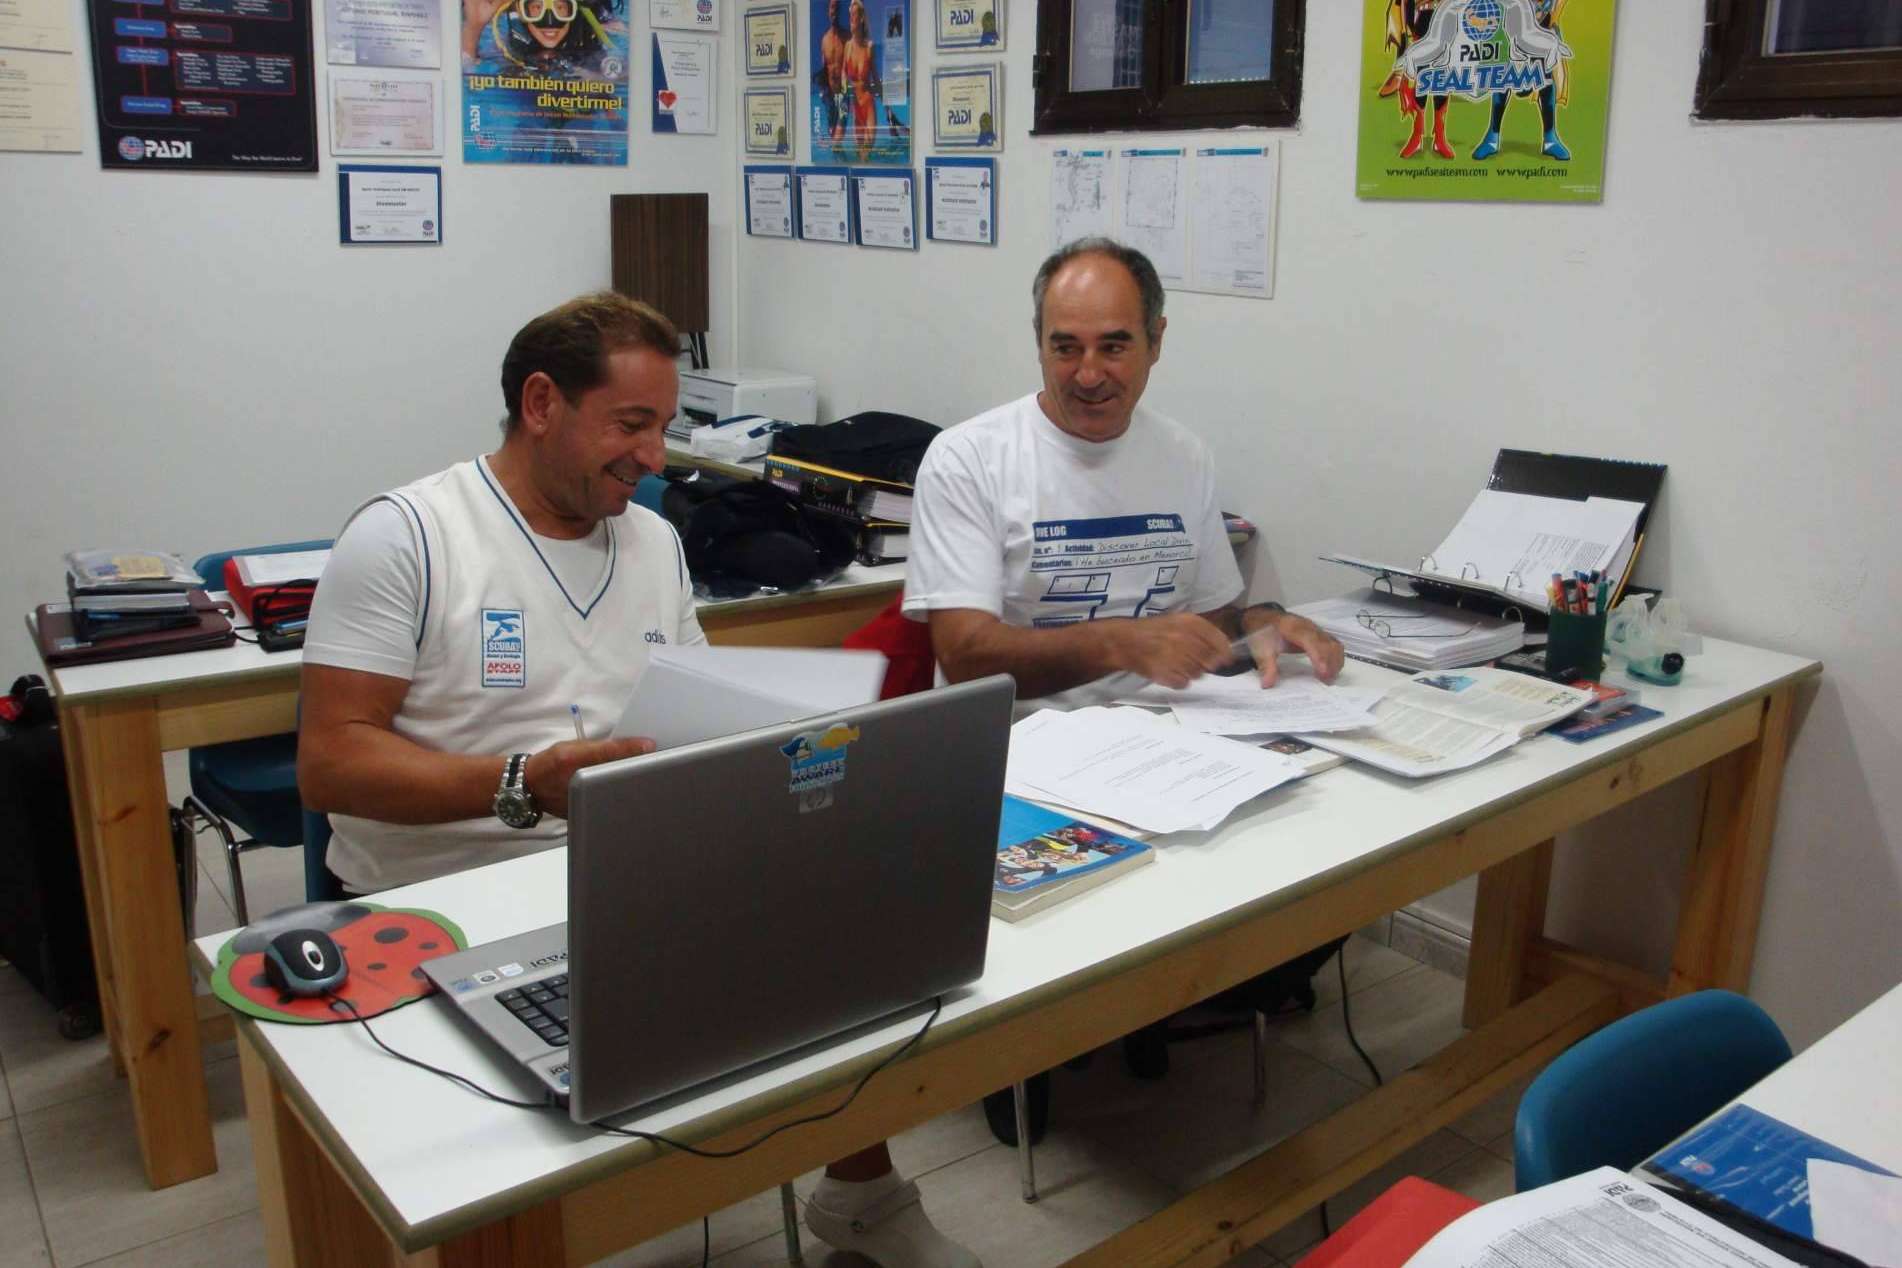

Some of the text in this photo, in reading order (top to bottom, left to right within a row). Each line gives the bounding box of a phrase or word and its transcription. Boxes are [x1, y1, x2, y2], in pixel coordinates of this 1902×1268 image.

[950, 9, 974, 26] PADI
[755, 43, 773, 57] PADI
[1459, 43, 1502, 63] PADI
[498, 74, 564, 91] también
[566, 79, 615, 94] quiero
[1416, 63, 1545, 92] SEAL TEAM
[537, 93, 624, 110] divertirme!
[470, 105, 481, 131] PADI
[948, 109, 972, 126] PADI
[755, 123, 773, 136] PADI
[144, 140, 193, 159] PADI
[1496, 166, 1568, 180] www.padi.com
